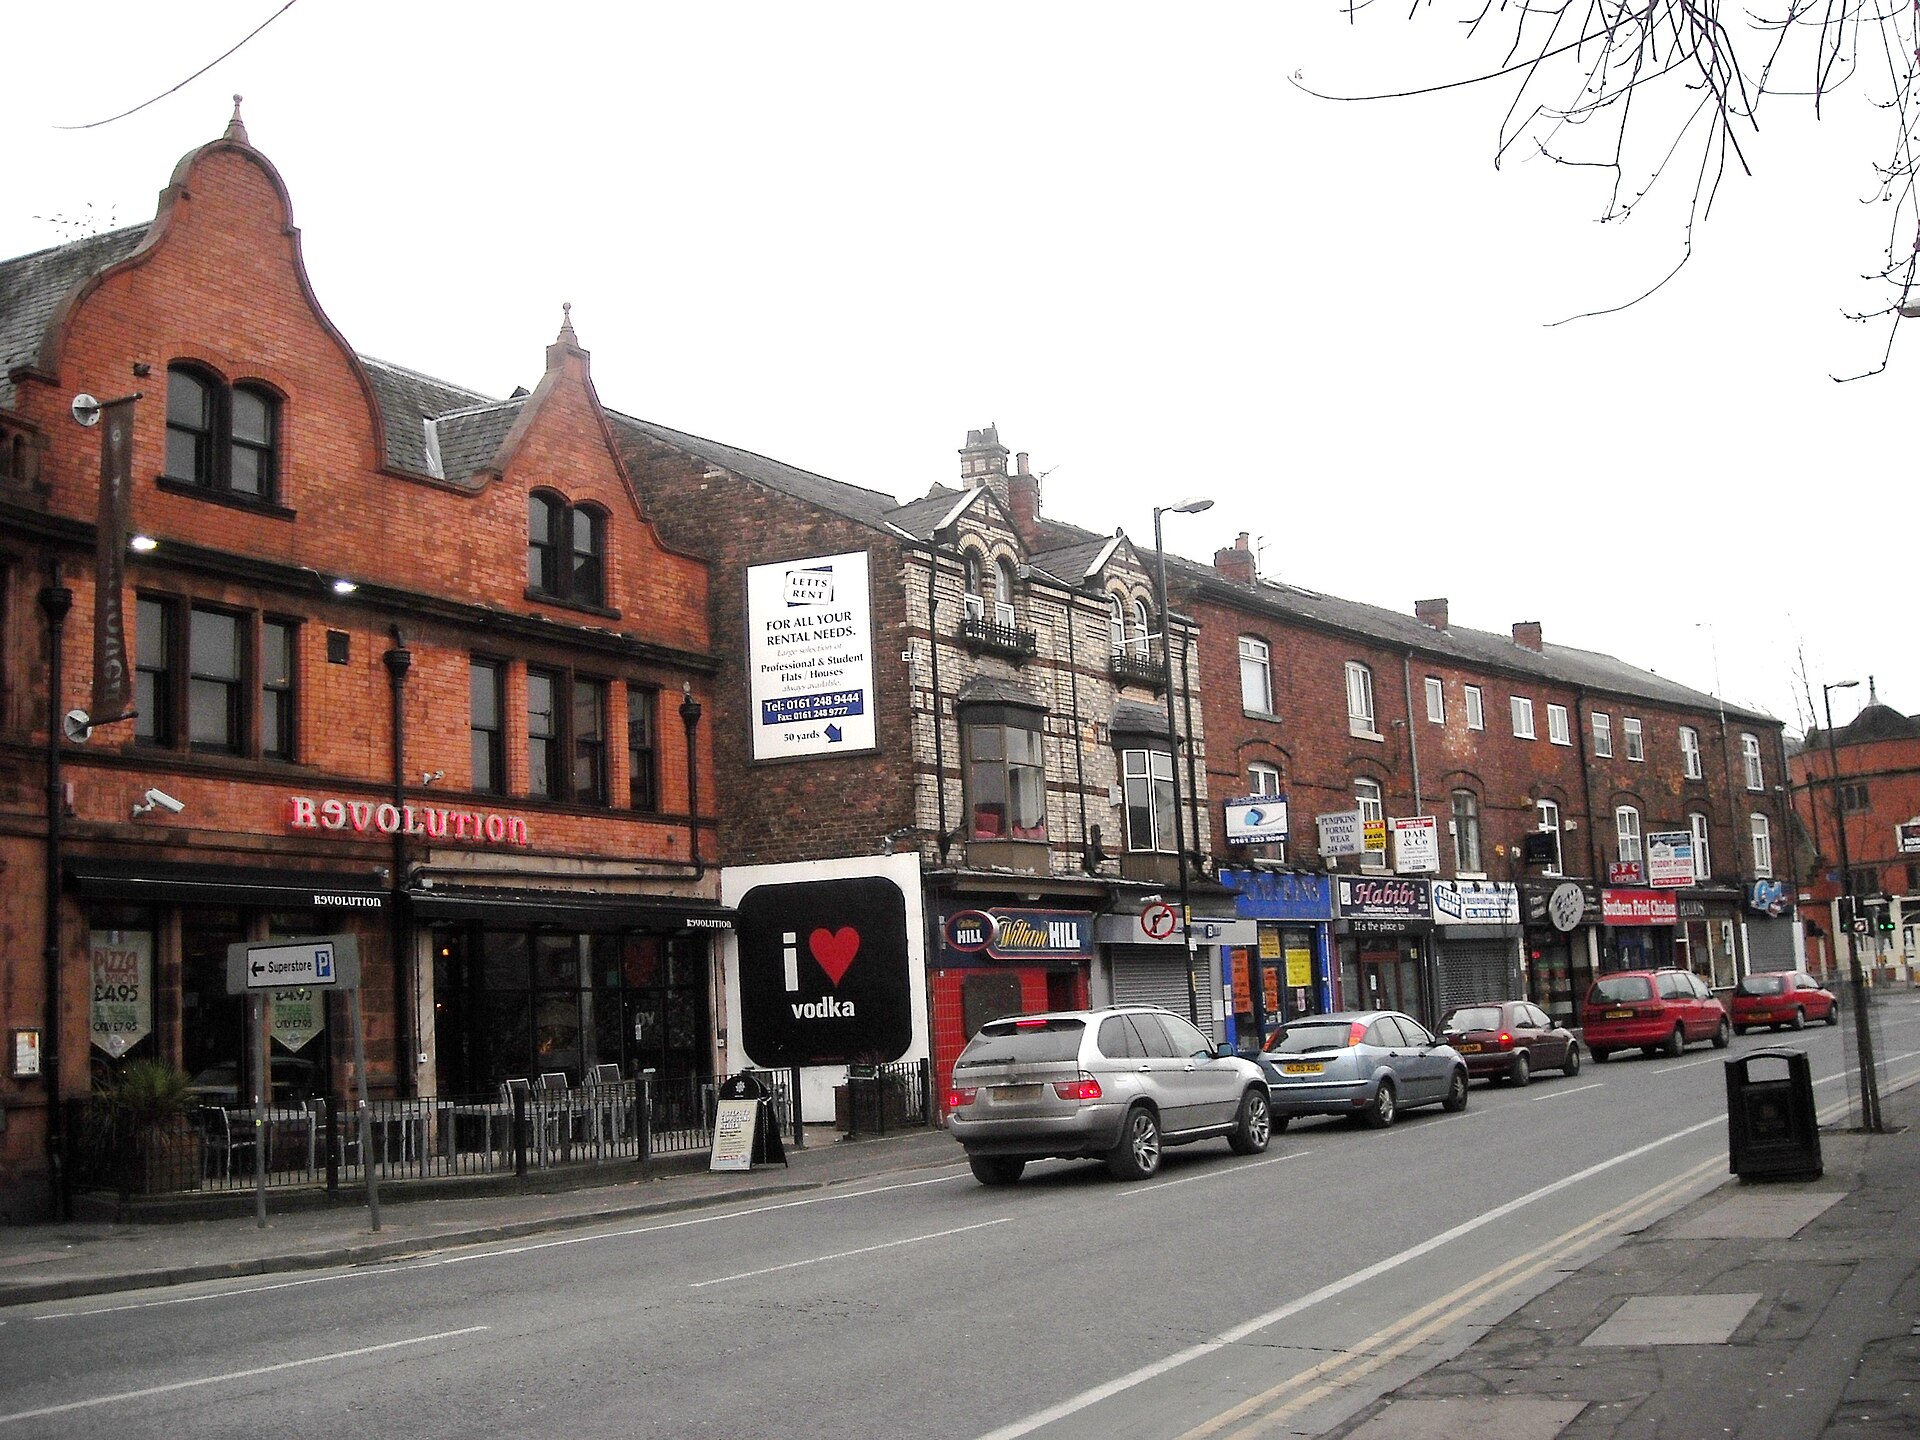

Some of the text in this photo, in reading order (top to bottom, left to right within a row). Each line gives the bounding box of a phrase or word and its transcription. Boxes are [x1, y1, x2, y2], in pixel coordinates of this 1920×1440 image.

[792, 577, 828, 588] LETTS
[792, 589, 824, 599] RENT
[766, 611, 852, 631] FOR ALL YOUR
[767, 626, 856, 646] RENTAL NEEDS.
[761, 654, 864, 673] Professional & Student
[781, 672, 802, 682] Flats
[810, 668, 844, 679] Houses
[765, 692, 860, 712] Tel: 0161 248 9444
[777, 713, 793, 722] Fax:
[793, 711, 812, 720] 0161
[813, 709, 828, 718] 248
[783, 730, 820, 743] 50 yards
[1329, 834, 1350, 843] WEAR
[1404, 829, 1427, 838] DAR
[1403, 838, 1412, 847] &
[1614, 873, 1638, 881] OPEN
[1354, 881, 1416, 905] Habibi
[1603, 899, 1633, 916] Southern
[1633, 899, 1650, 916] Fried
[1650, 899, 1677, 916] Chicken
[998, 916, 1081, 948] William HILL
[1367, 921, 1379, 931] the
[1380, 921, 1397, 932] place
[957, 929, 984, 944] HILL
[94, 949, 138, 973] PIZZA
[268, 960, 312, 975] Superstore
[782, 932, 799, 991] i
[94, 984, 139, 1002] £4.95
[791, 996, 856, 1019] vodka
[113, 1021, 138, 1032] £7.95
